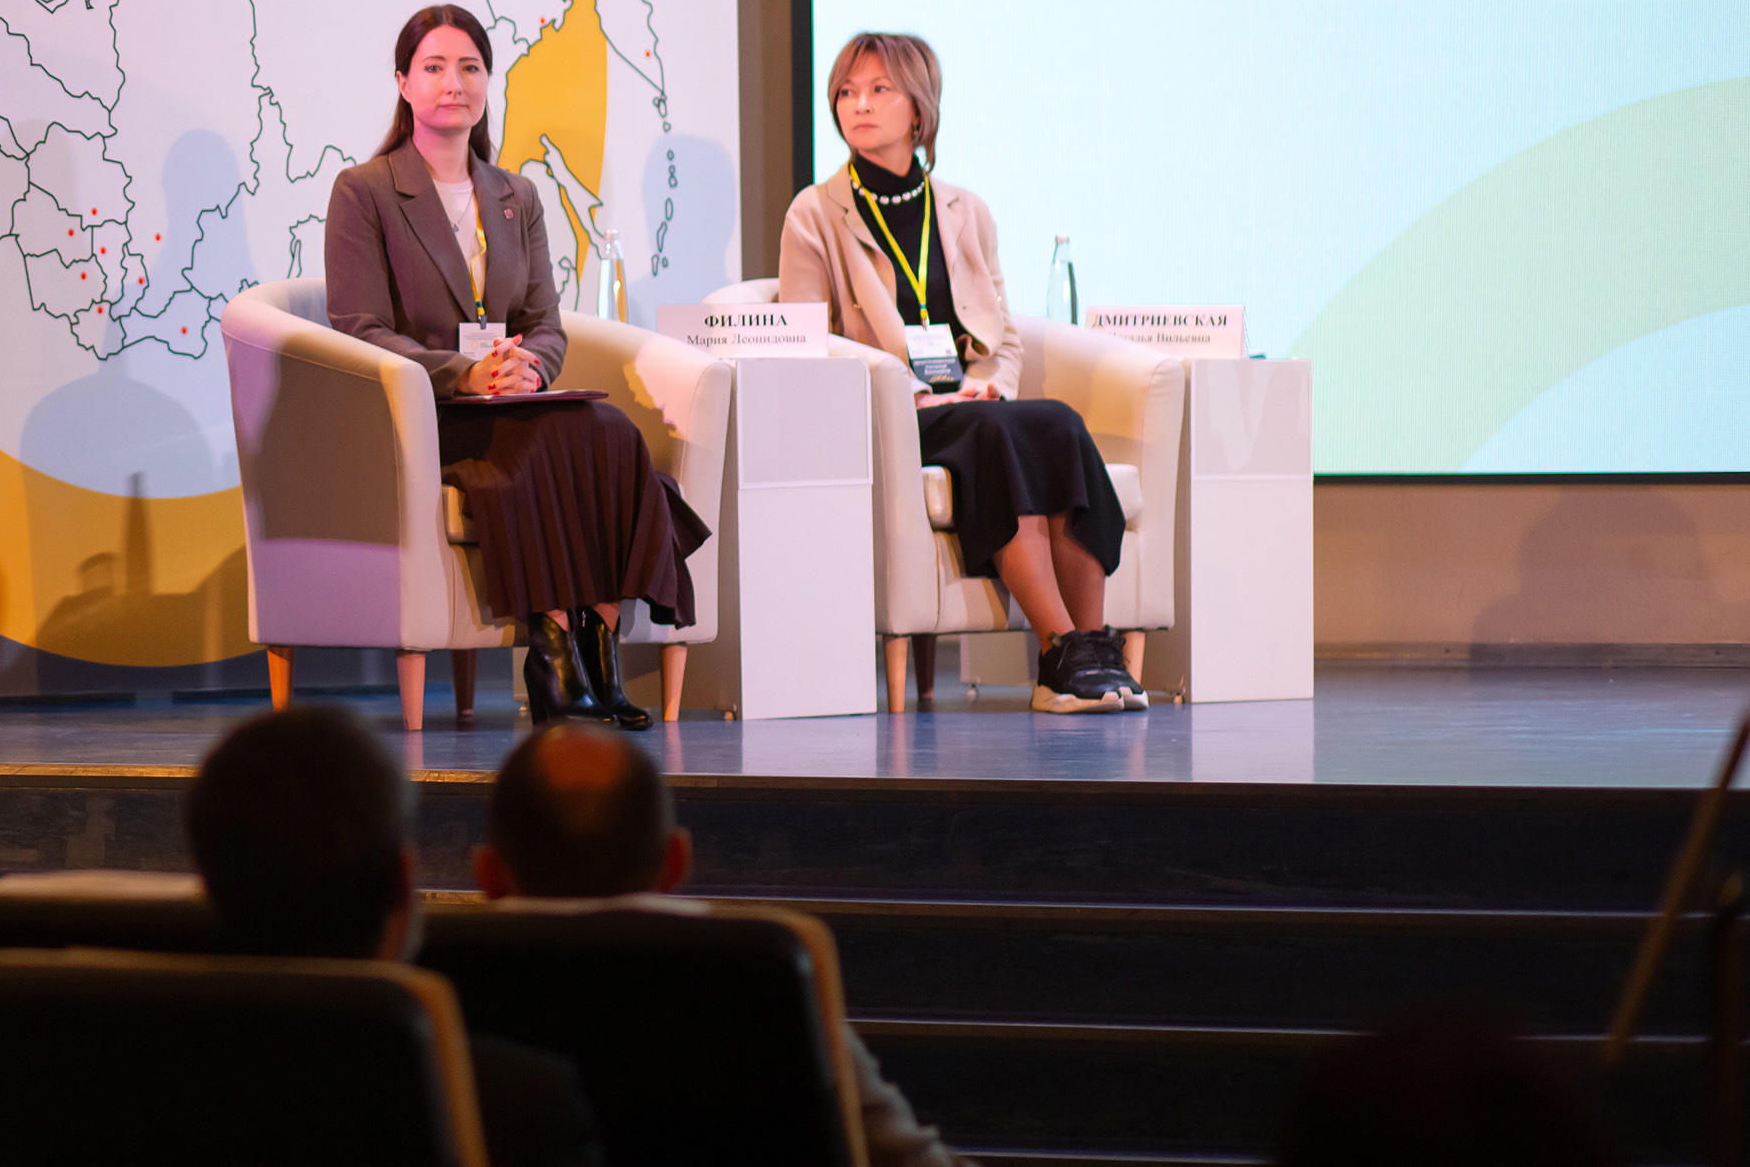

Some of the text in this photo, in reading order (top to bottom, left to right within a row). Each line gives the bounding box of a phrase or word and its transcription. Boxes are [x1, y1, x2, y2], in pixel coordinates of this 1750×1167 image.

[704, 314, 788, 328] ФИЛИНА
[1092, 314, 1228, 328] ДМИТРИЕВСКАЯ
[687, 333, 806, 348] Мария Леонидовна
